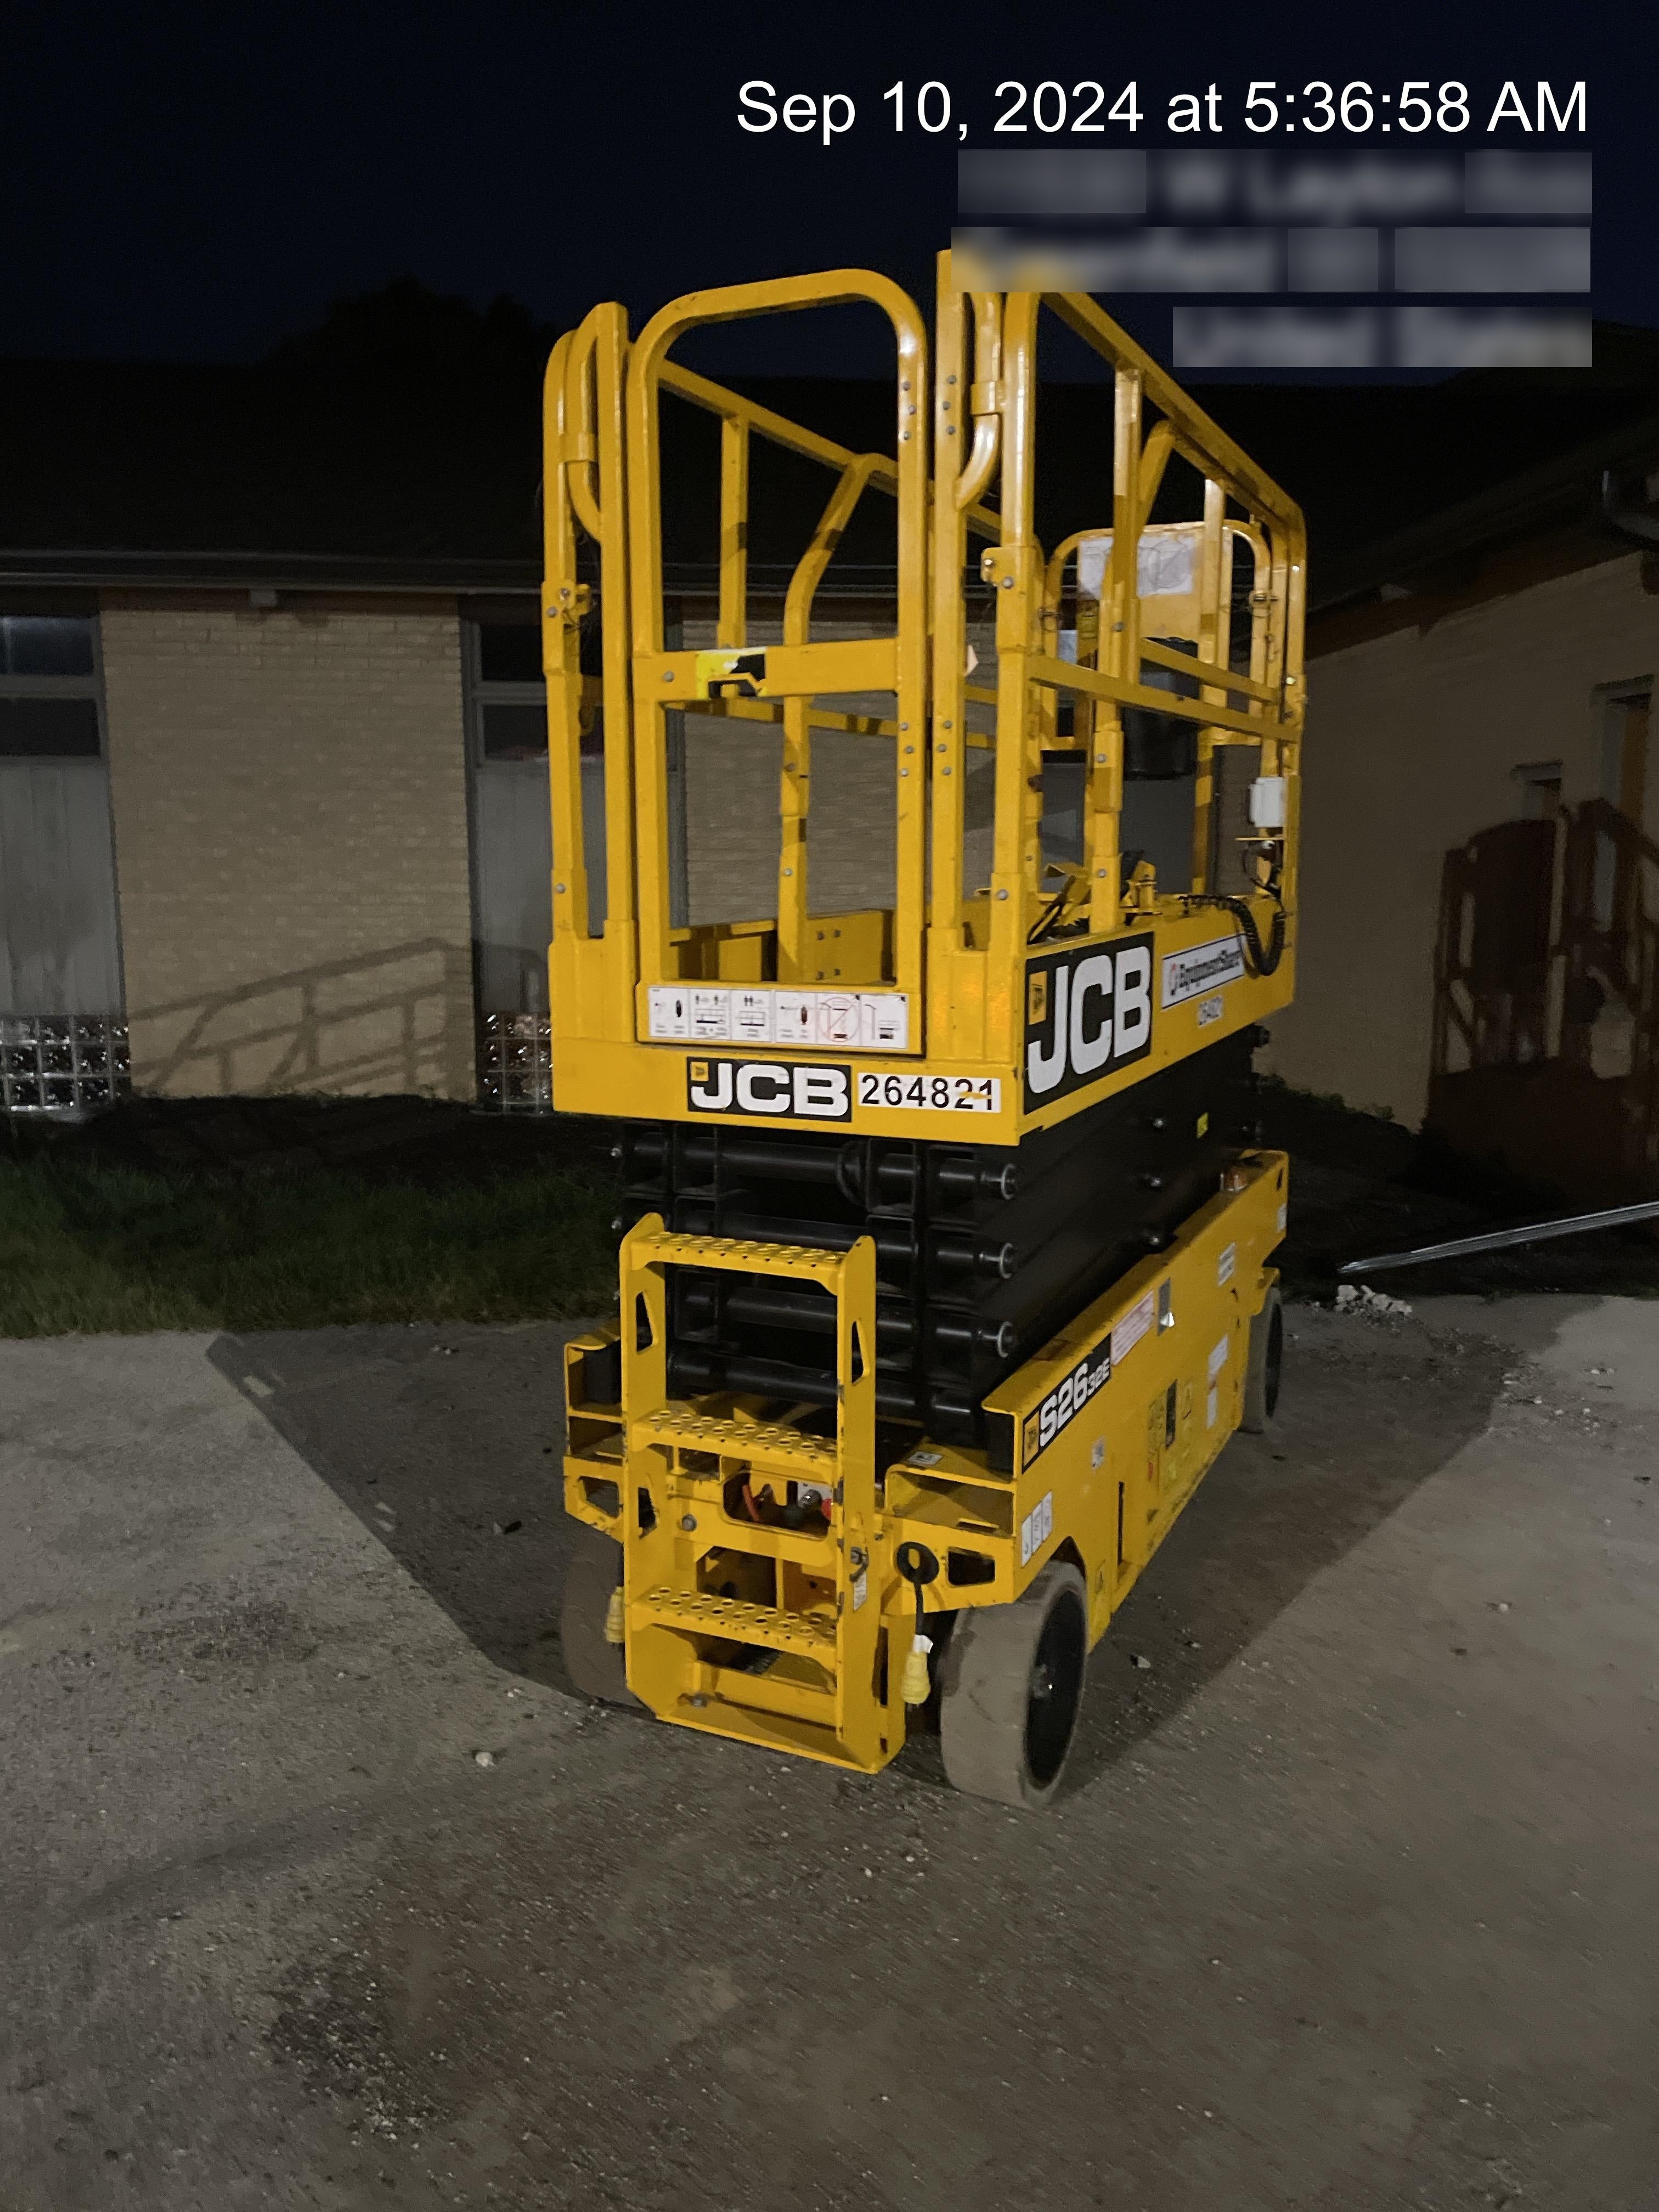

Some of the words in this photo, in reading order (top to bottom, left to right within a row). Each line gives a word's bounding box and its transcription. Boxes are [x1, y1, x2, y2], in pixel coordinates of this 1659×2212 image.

[1028, 946, 1151, 1093] JCB
[691, 1063, 849, 1116] JCB
[862, 1075, 992, 1110] 264821
